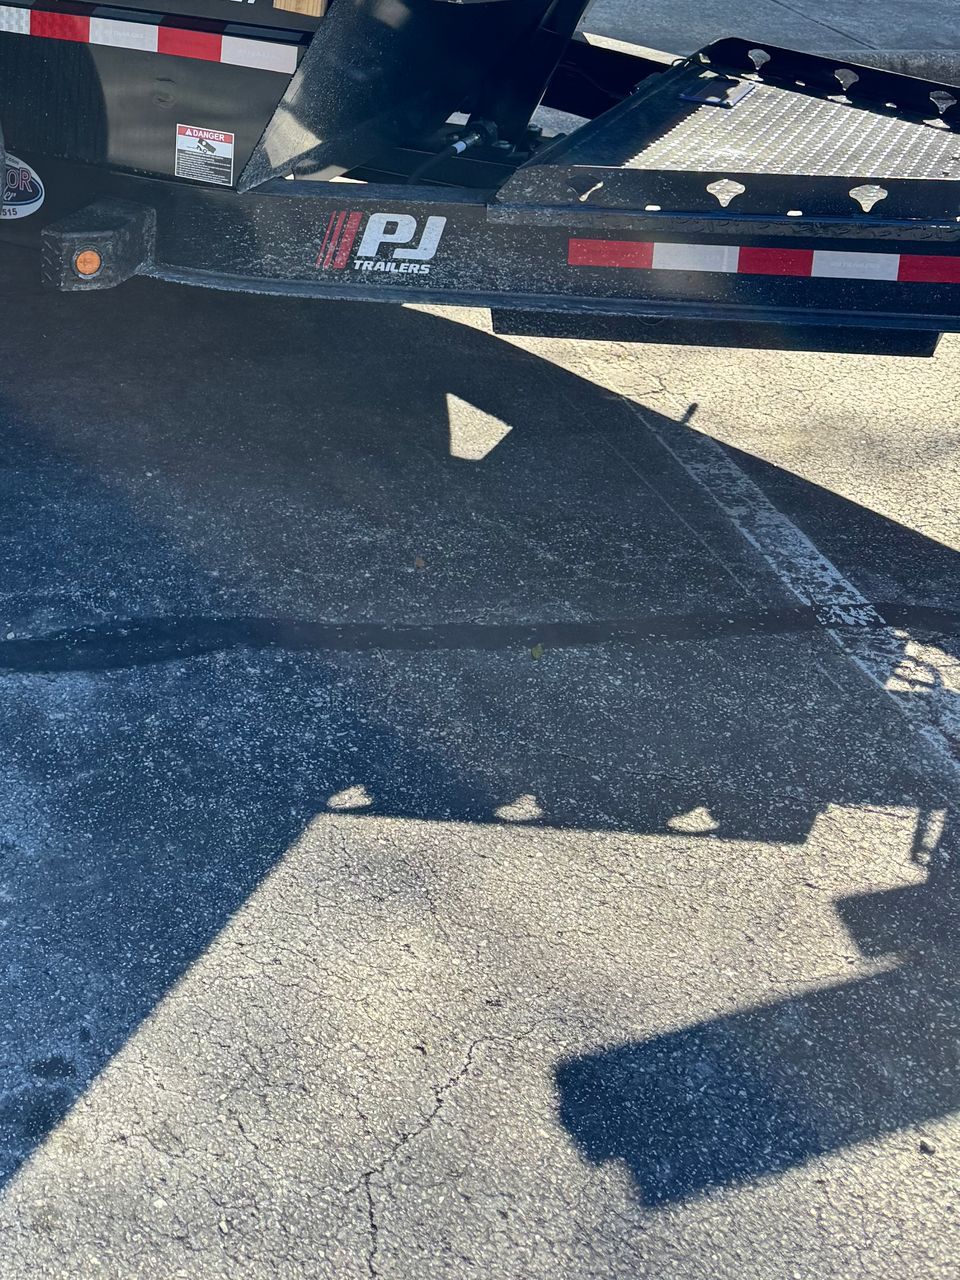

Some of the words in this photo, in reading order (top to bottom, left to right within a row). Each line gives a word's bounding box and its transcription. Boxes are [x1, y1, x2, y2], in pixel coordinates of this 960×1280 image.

[192, 129, 225, 142] DANGER
[6, 166, 33, 193] OR
[356, 212, 447, 261] PJ
[353, 260, 431, 274] TRAILERS
